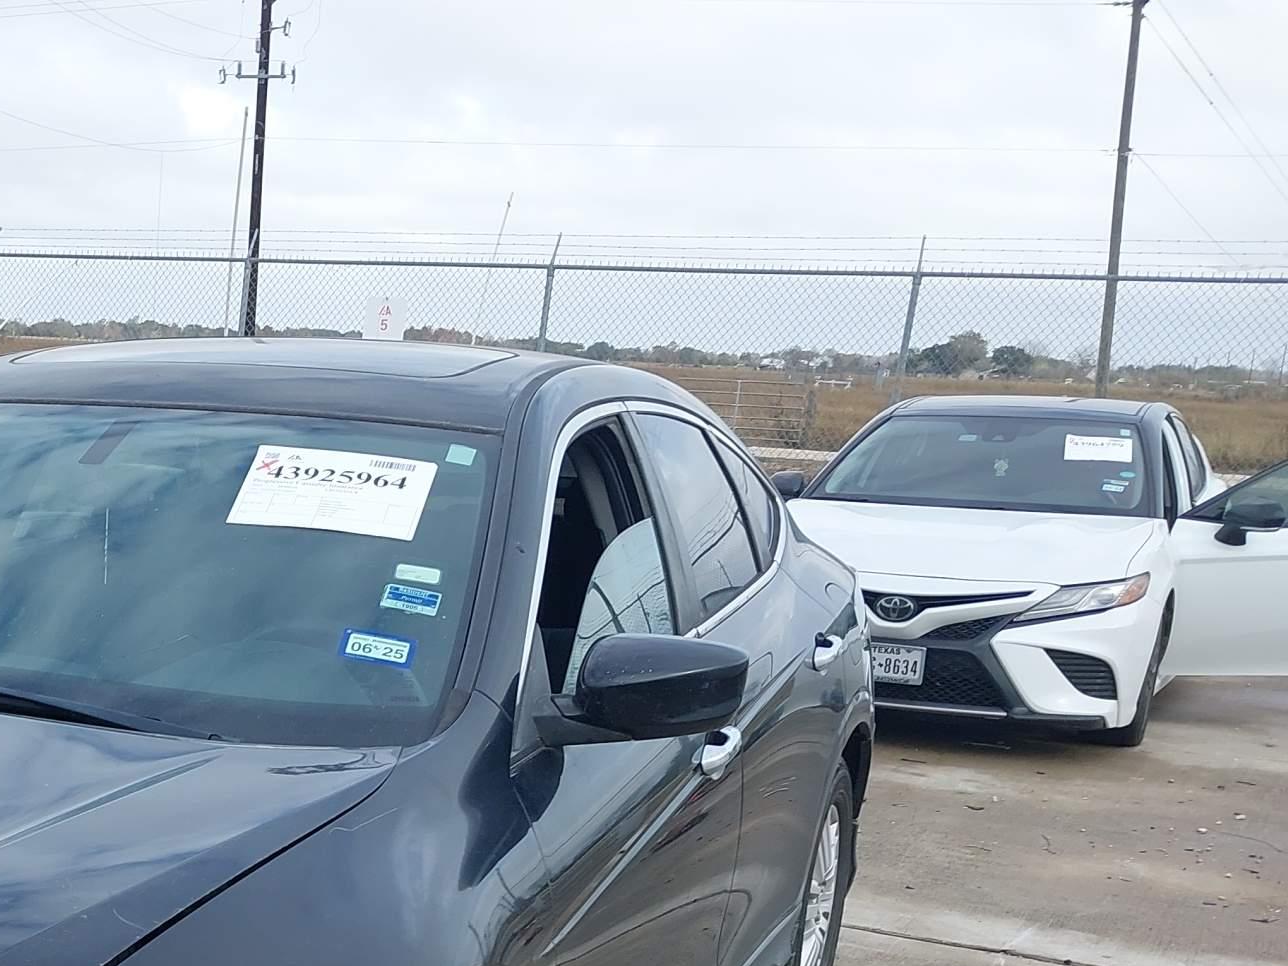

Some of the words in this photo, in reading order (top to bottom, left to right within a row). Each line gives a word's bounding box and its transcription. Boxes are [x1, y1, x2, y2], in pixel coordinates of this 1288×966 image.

[380, 318, 389, 331] 5
[267, 465, 408, 490] 43925964
[351, 641, 373, 654] 06
[382, 646, 405, 660] 25
[872, 646, 901, 655] TEXAS
